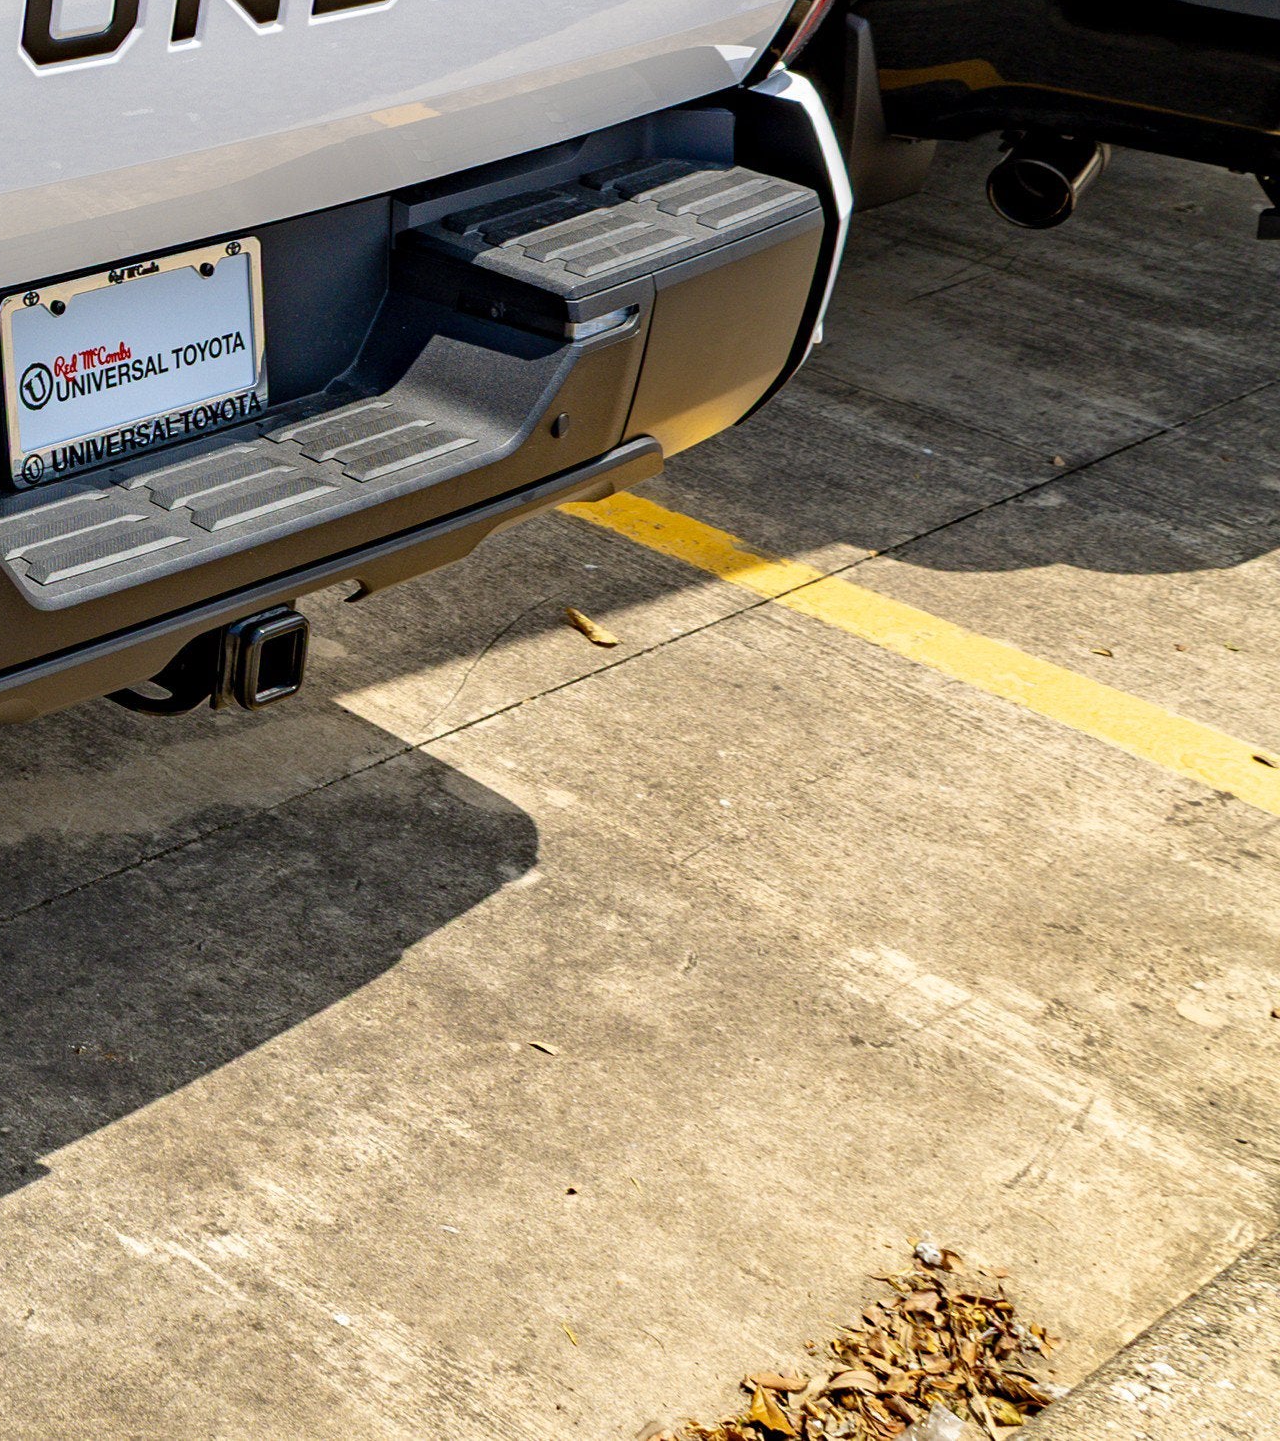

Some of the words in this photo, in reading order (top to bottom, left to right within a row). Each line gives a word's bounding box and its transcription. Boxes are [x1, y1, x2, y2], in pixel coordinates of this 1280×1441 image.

[54, 355, 77, 382] Red
[79, 341, 132, 370] McCombs
[56, 353, 169, 402] UNIVERSAL
[171, 331, 246, 369] TOYOTA
[51, 416, 179, 473] UNIVERSAL
[180, 390, 262, 434] TOYOTA
